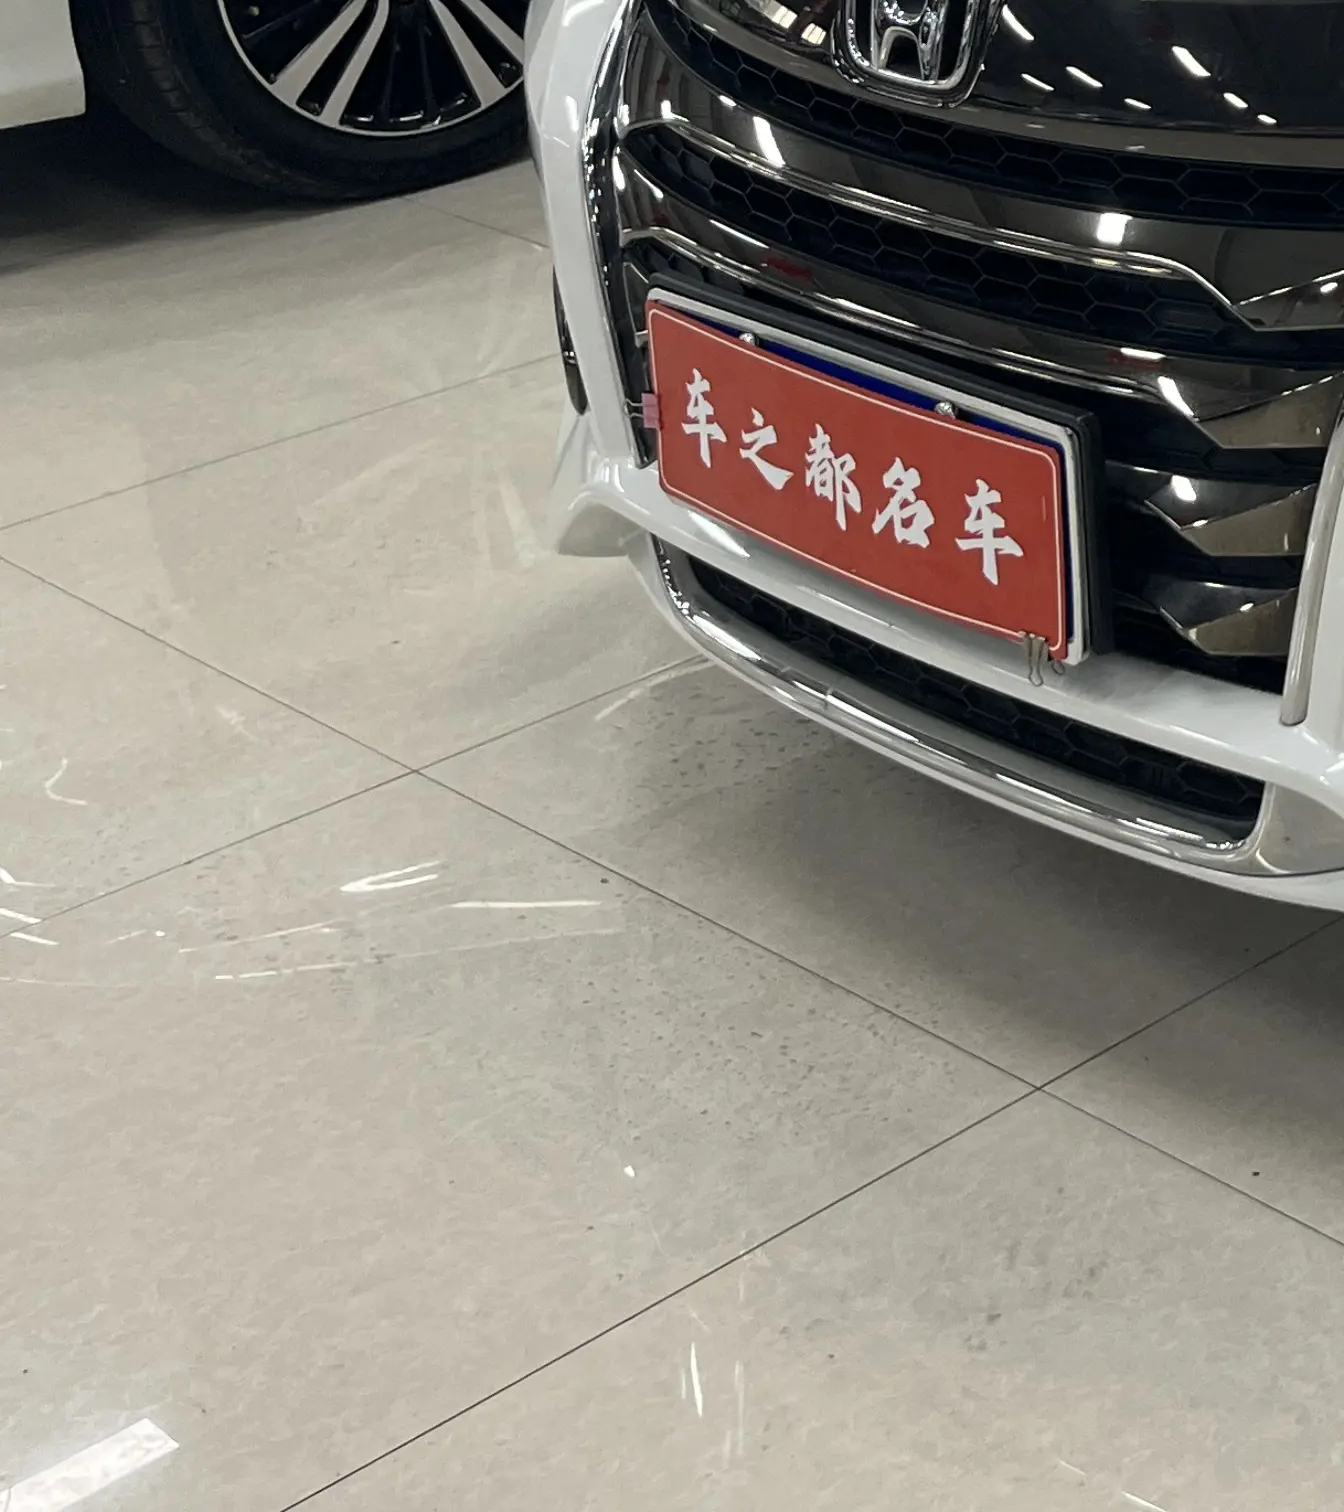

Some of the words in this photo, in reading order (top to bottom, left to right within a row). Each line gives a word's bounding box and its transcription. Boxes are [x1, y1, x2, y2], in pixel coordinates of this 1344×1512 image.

[681, 368, 1024, 586] 车之都名车
